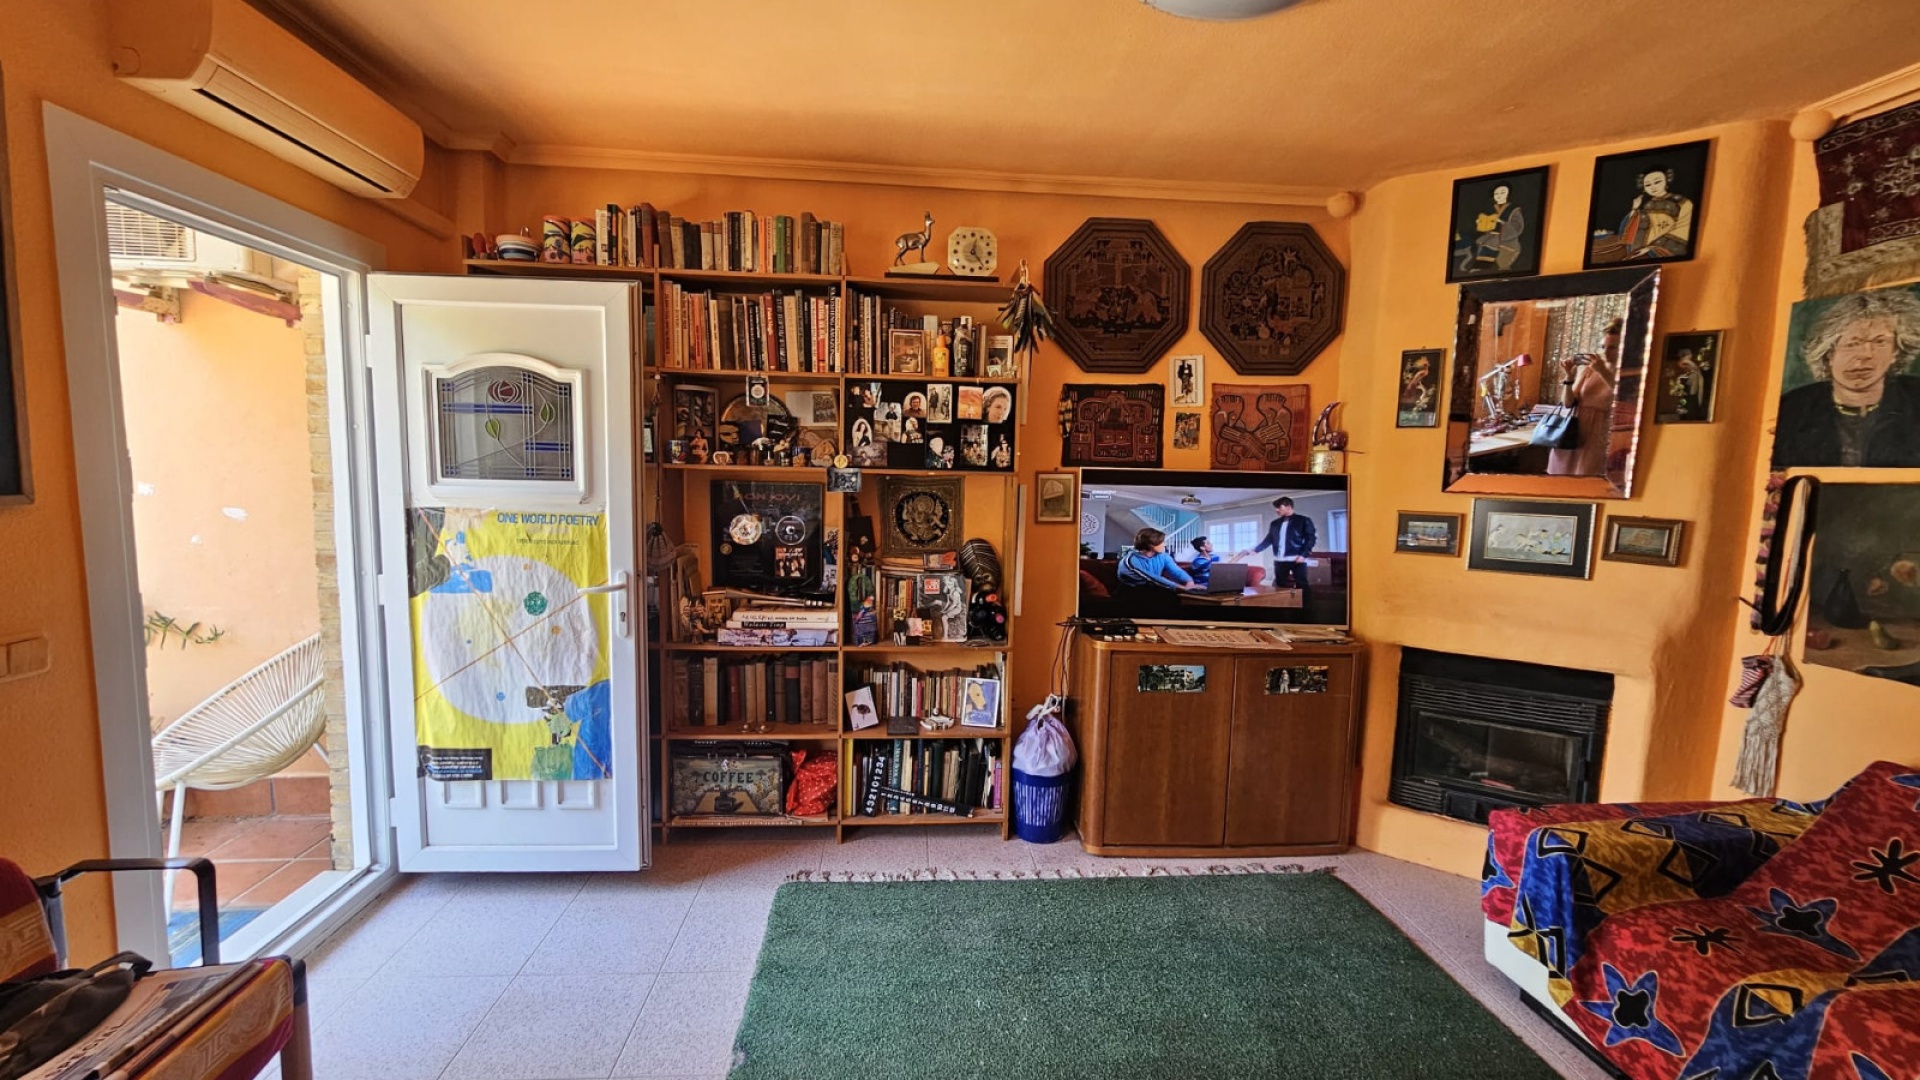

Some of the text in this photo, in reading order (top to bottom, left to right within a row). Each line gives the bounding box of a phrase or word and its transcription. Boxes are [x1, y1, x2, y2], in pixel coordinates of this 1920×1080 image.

[497, 512, 600, 526] ONE WORLD POETRY
[702, 771, 755, 784] COFFEE
